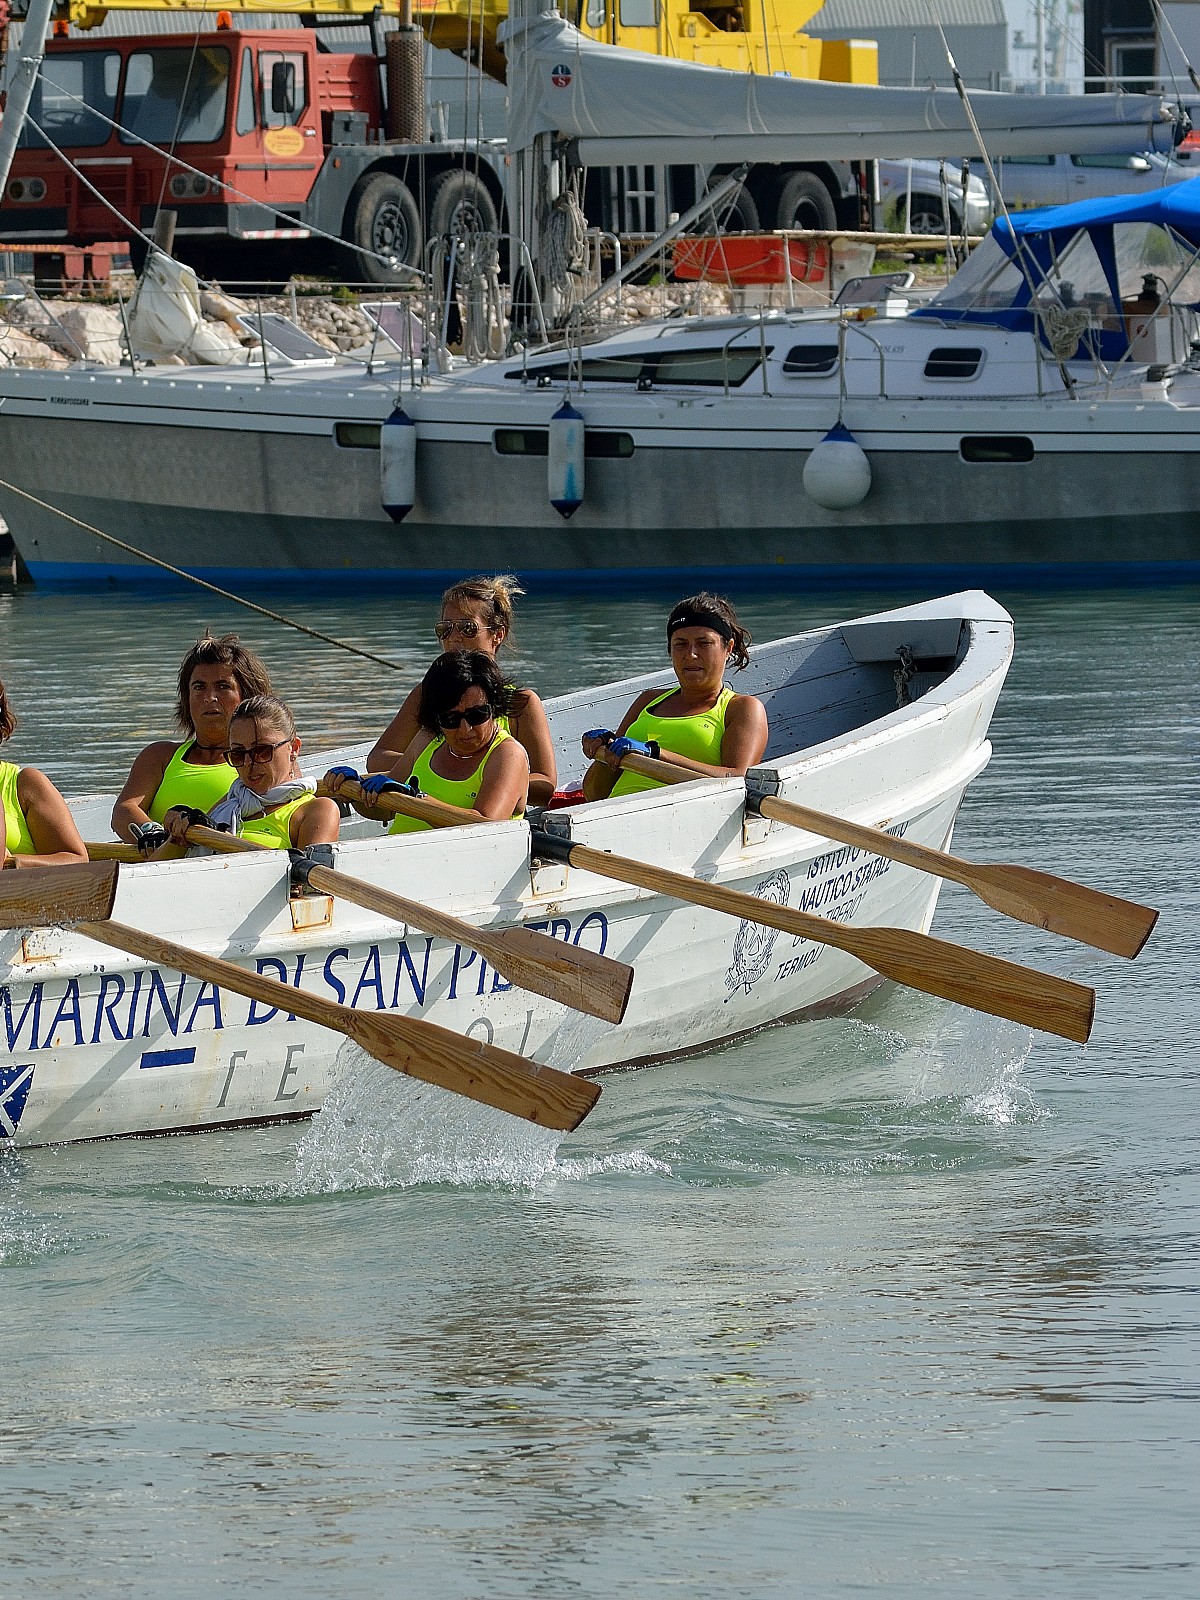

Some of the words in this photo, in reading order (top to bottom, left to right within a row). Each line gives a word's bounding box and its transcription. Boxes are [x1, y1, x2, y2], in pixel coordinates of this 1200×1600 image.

[799, 870, 853, 912] NAUTICO
[245, 953, 308, 1026] DI
[323, 936, 435, 1010] SAN
[774, 943, 826, 982] TERMOLI
